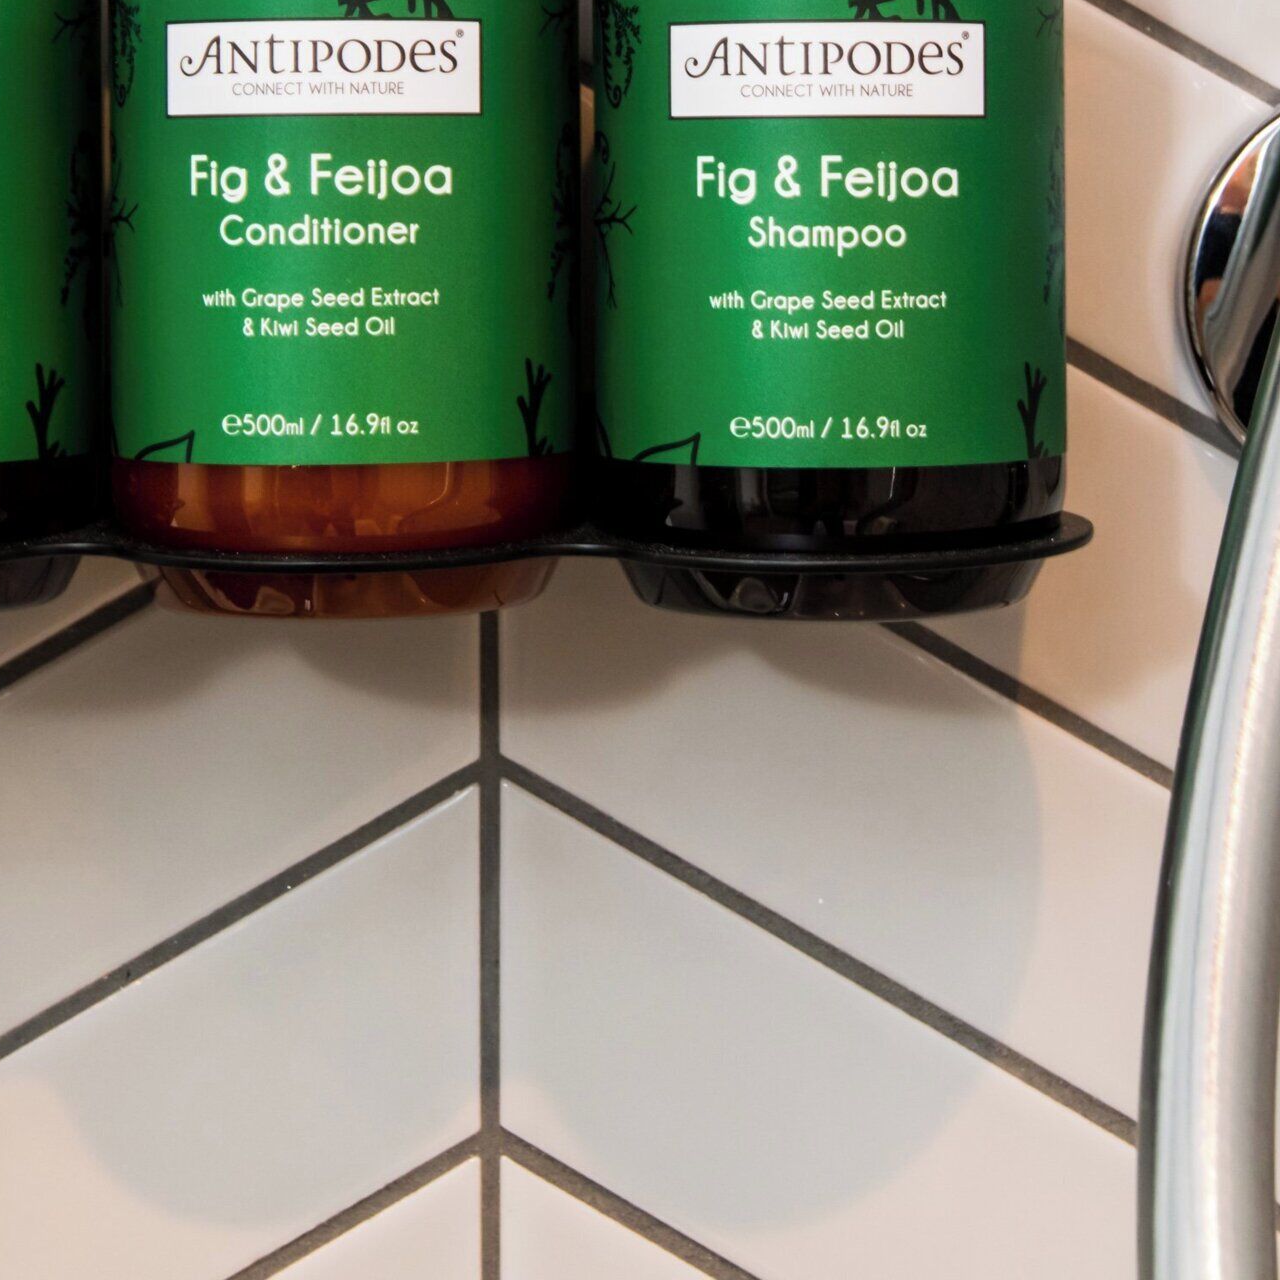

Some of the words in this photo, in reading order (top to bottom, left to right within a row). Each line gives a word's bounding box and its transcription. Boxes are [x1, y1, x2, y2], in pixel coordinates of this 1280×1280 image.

[232, 82, 303, 96] CONNECT
[308, 81, 345, 95] WITH
[350, 81, 405, 95] NATURE
[740, 84, 814, 98] CONNECT
[819, 83, 855, 97] WITH
[860, 83, 914, 97] NATURE
[190, 154, 249, 204] Fig
[264, 152, 292, 197] &
[310, 152, 454, 200] Feijoa
[696, 155, 758, 206] Fig
[774, 154, 802, 199] &
[820, 154, 961, 202] Feijoa
[219, 213, 421, 246] Conditioner
[748, 215, 908, 257] Shampoo
[202, 288, 236, 307] with
[241, 287, 305, 313] Grape
[310, 287, 365, 308] Seed
[371, 286, 441, 307] Extract
[709, 290, 745, 309] with
[750, 289, 815, 315] Grape
[821, 289, 875, 310] Seed
[881, 289, 948, 310] Extract
[242, 317, 255, 337] &
[260, 317, 299, 337] Kiwi
[305, 316, 359, 337] Seed
[365, 316, 395, 336] Oil
[751, 319, 764, 340] &
[770, 319, 809, 339] Kiwi
[815, 319, 869, 340] Seed
[875, 319, 904, 339] Oil
[309, 413, 323, 436] /
[330, 412, 391, 437] 16.9fl
[396, 420, 420, 435] oz
[820, 416, 833, 439] /
[841, 415, 901, 440] 16.9fl
[905, 423, 928, 438] oz
